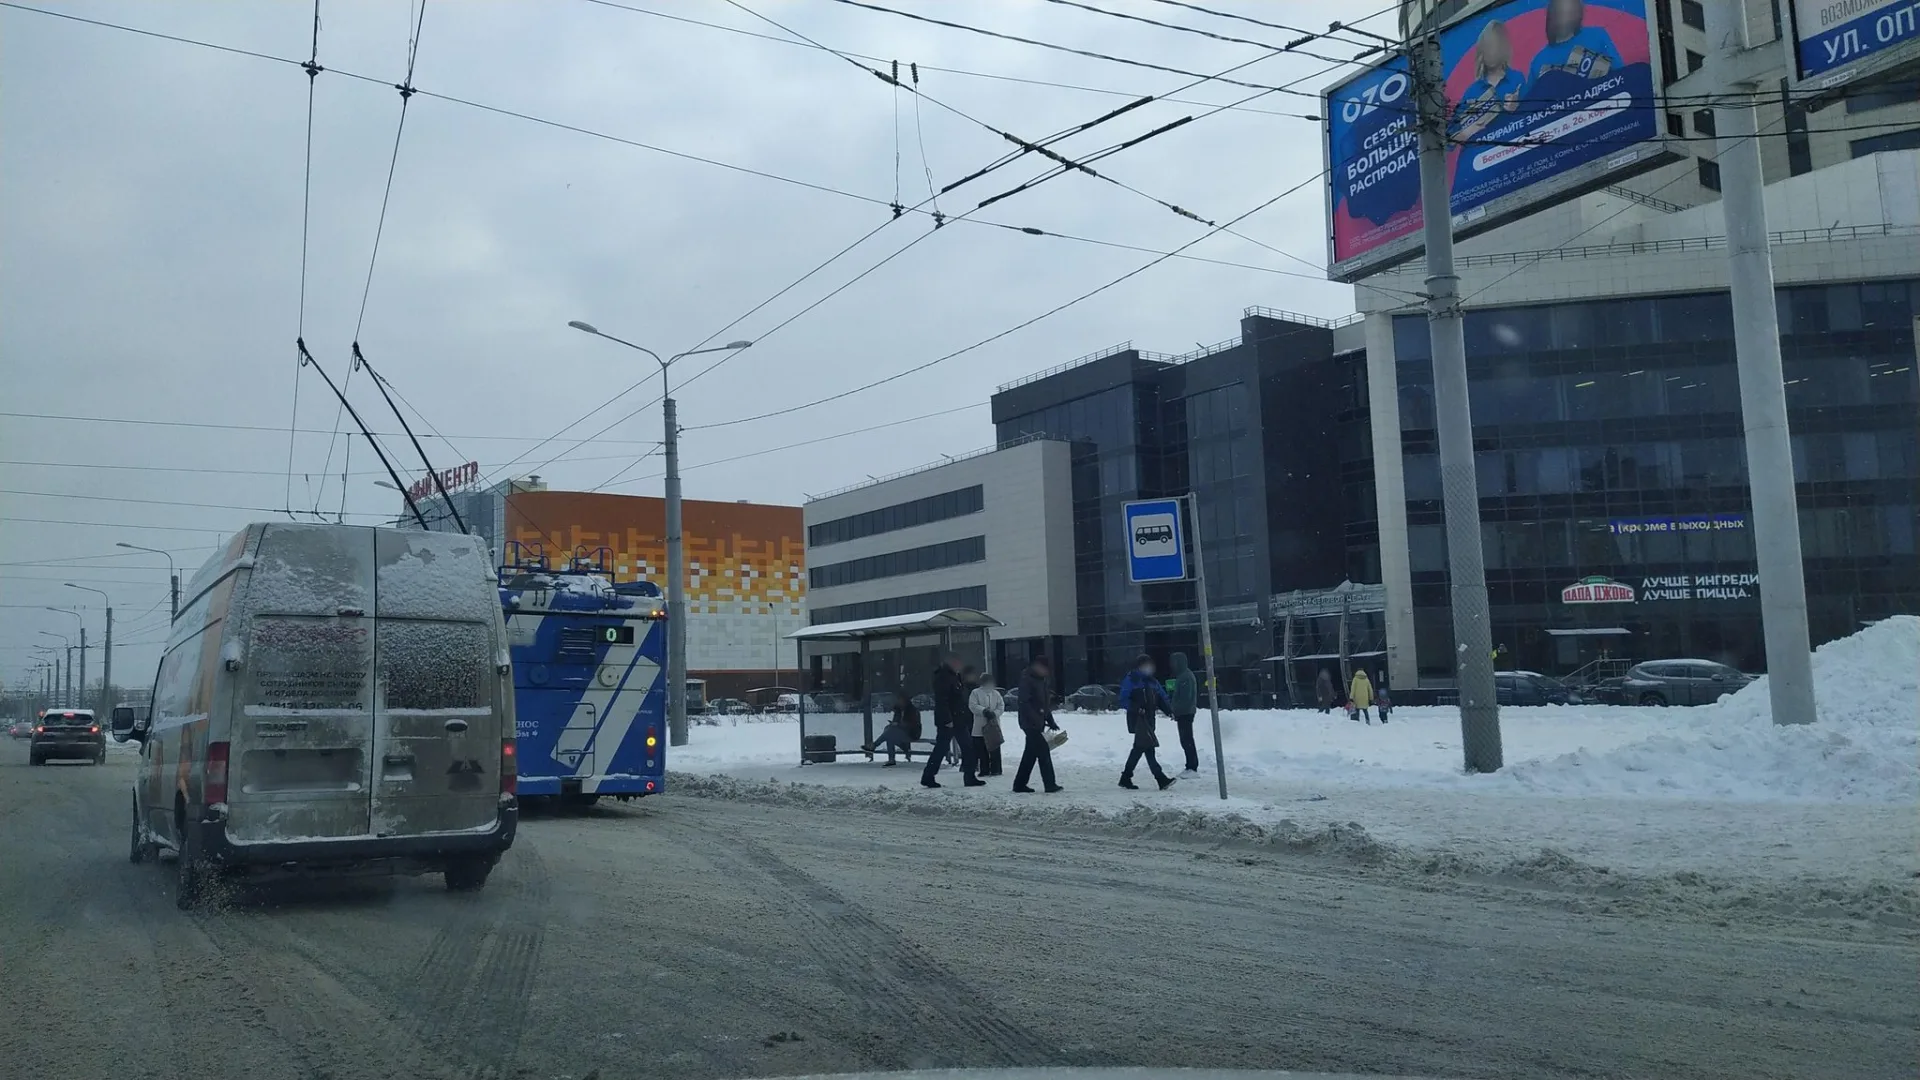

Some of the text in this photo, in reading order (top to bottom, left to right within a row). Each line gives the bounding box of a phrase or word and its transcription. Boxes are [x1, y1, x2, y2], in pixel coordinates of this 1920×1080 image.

[1823, 29, 1866, 64] УЛ.
[1526, 101, 1565, 126] ЗАКАЗЫ
[1567, 94, 1582, 108] ПО
[1584, 75, 1625, 100] АДРЕСУ:
[1363, 115, 1408, 150] СЕЗОН
[1349, 148, 1420, 197] РАСПРОДА
[1563, 585, 1633, 601] ПАПА ДЖОНС
[1643, 573, 1760, 588] ЛУЧШЕ ИНГРЕДИ
[1643, 587, 1752, 601] ЛУЧШЕ ПИЦЦА.
